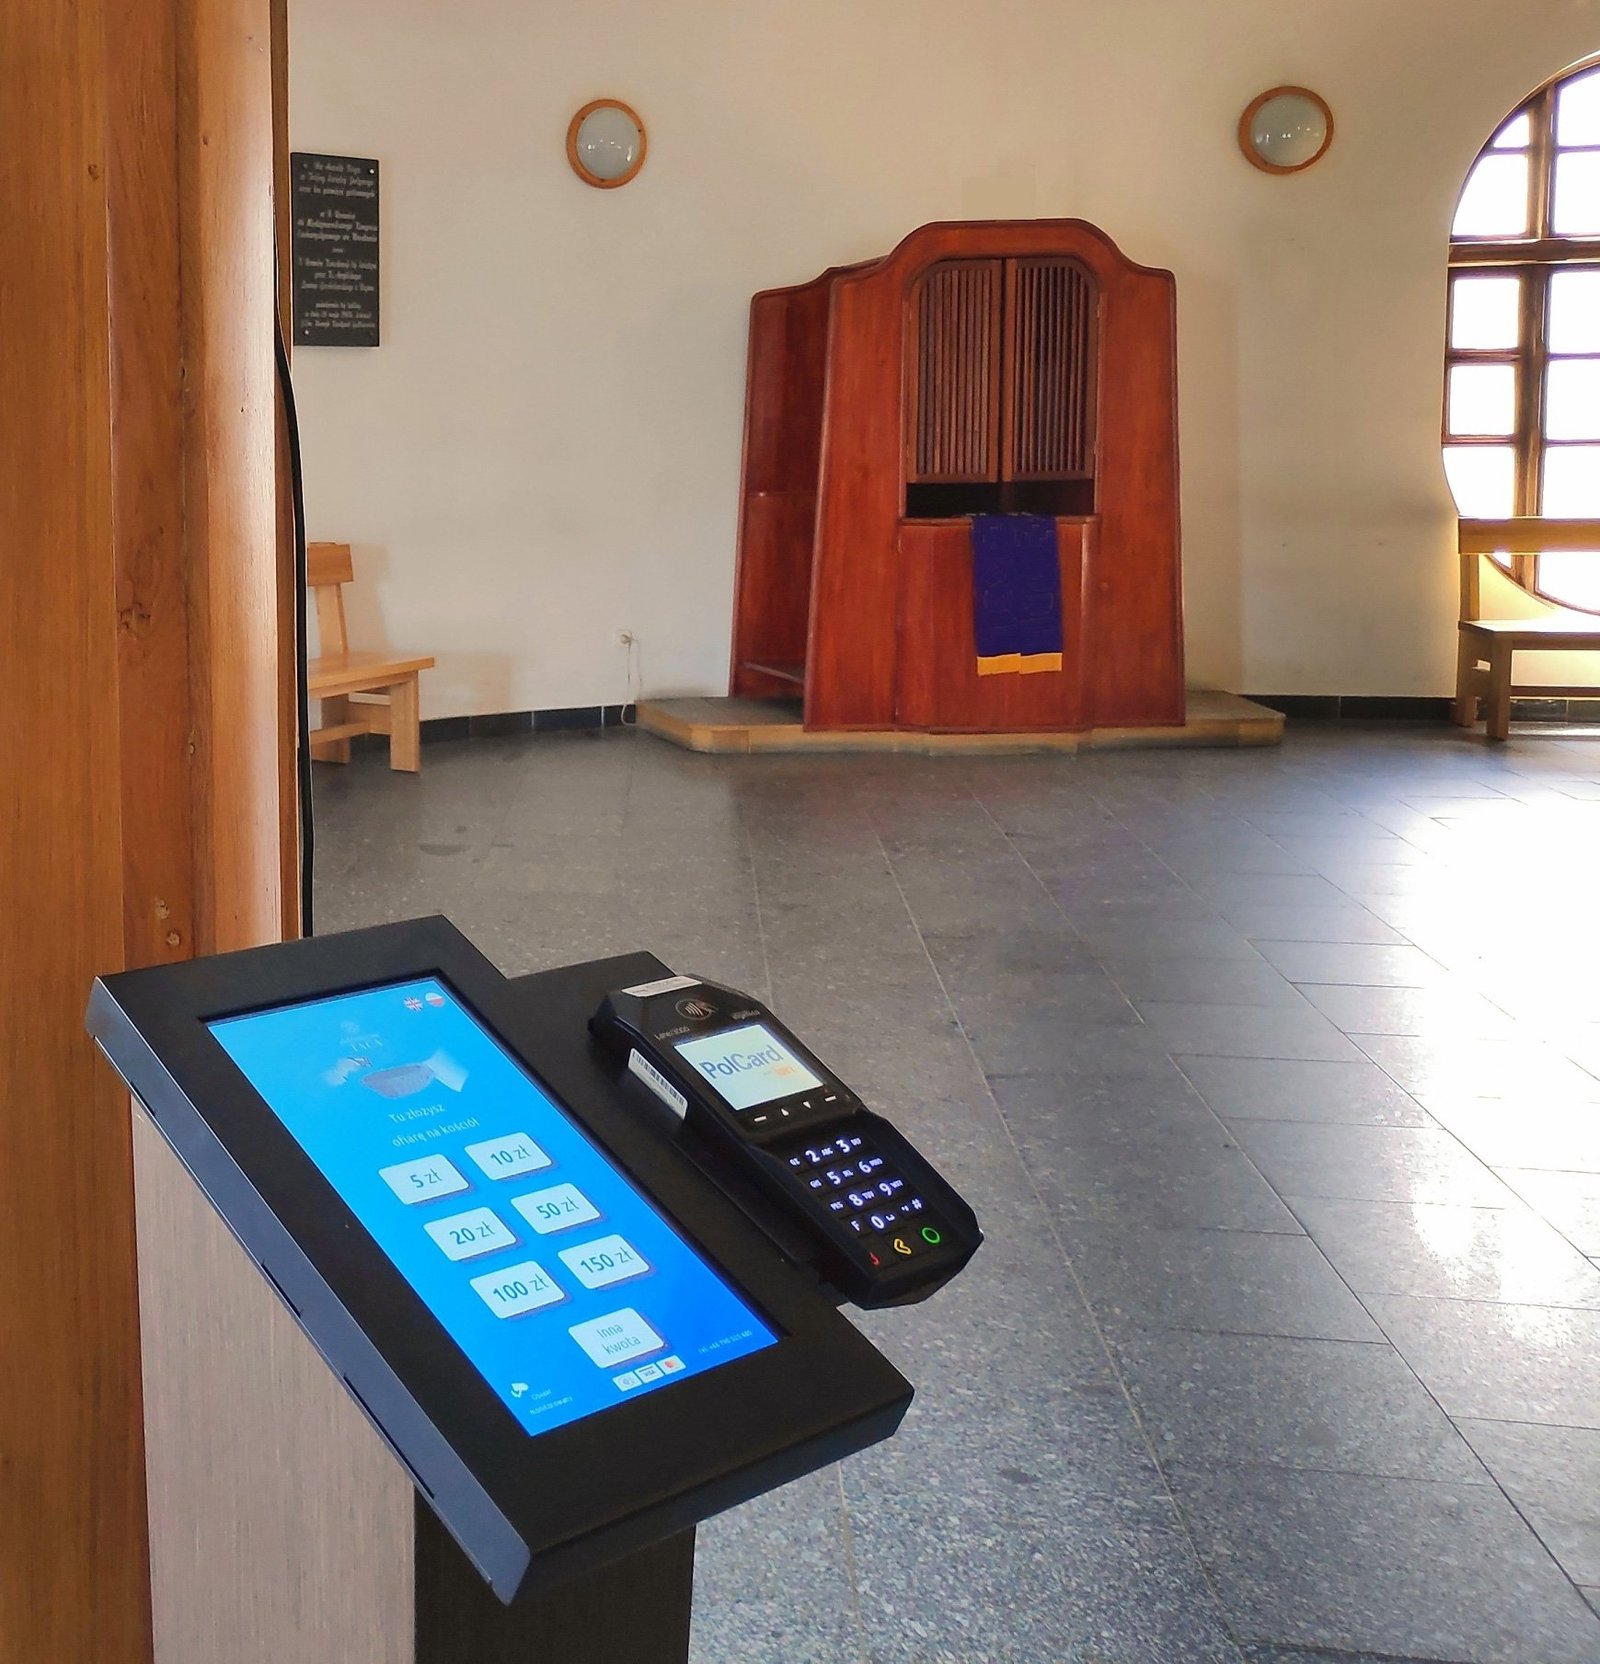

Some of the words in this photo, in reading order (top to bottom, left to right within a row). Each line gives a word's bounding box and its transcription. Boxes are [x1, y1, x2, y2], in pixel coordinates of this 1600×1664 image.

[699, 1045, 784, 1079] PolCard
[389, 1112, 405, 1125] Tu
[393, 1130, 427, 1147] ofiarę
[428, 1127, 442, 1138] na
[439, 1117, 480, 1135] kościół
[490, 1149, 513, 1166] 10
[513, 1143, 532, 1160] zł
[805, 1150, 820, 1163] 2
[836, 1139, 850, 1153] 3
[410, 1174, 424, 1188] 5
[424, 1168, 441, 1185] zł
[826, 1171, 841, 1185] 5
[858, 1160, 872, 1174] 6
[849, 1193, 864, 1207] 8
[879, 1183, 892, 1196] 9
[536, 1201, 560, 1219] 50
[560, 1196, 579, 1213] zł
[851, 1220, 861, 1232] F
[871, 1215, 885, 1229] 0
[911, 1198, 923, 1210] #
[449, 1228, 475, 1245] 20
[476, 1221, 495, 1239] zł
[580, 1254, 615, 1274] 150
[615, 1246, 633, 1264] zł
[493, 1281, 528, 1303] 100
[529, 1274, 550, 1293] zł
[596, 1322, 624, 1339] Inna
[602, 1334, 641, 1355] kwota
